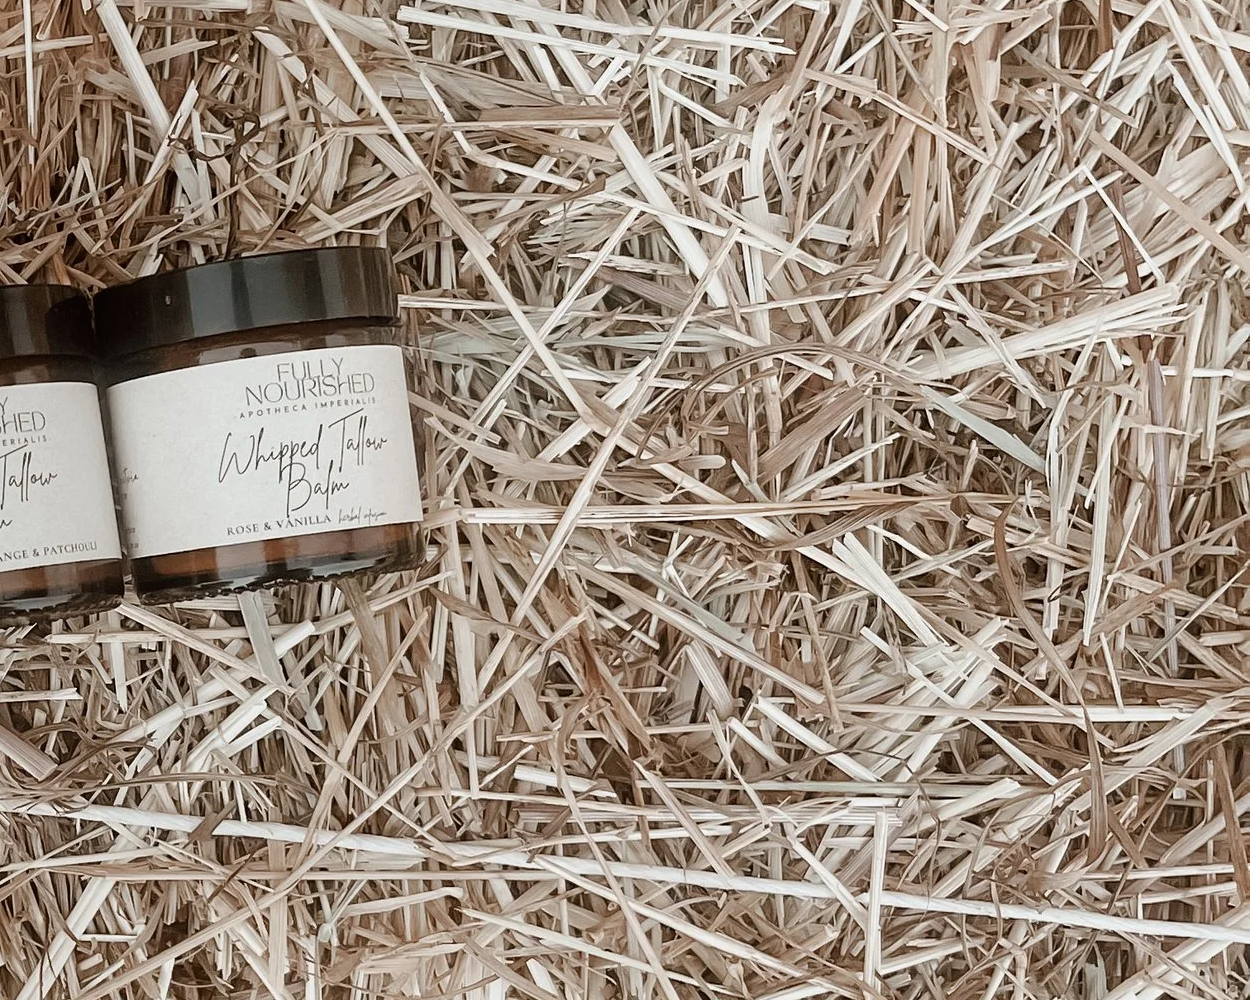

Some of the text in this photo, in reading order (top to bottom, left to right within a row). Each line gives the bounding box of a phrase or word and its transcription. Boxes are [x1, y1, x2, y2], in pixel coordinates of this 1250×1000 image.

[276, 357, 344, 382] FULLY
[245, 372, 375, 406] NOURISHED
[239, 398, 376, 419] APOTHECA IMPERIALIS
[218, 408, 388, 484] Whipped Tallow
[279, 459, 350, 517] Balm
[226, 523, 260, 536] ROSE
[263, 521, 273, 531] &
[276, 514, 331, 529] VANILLA
[32, 548, 40, 557] &
[43, 541, 98, 557] PATCHOULI
